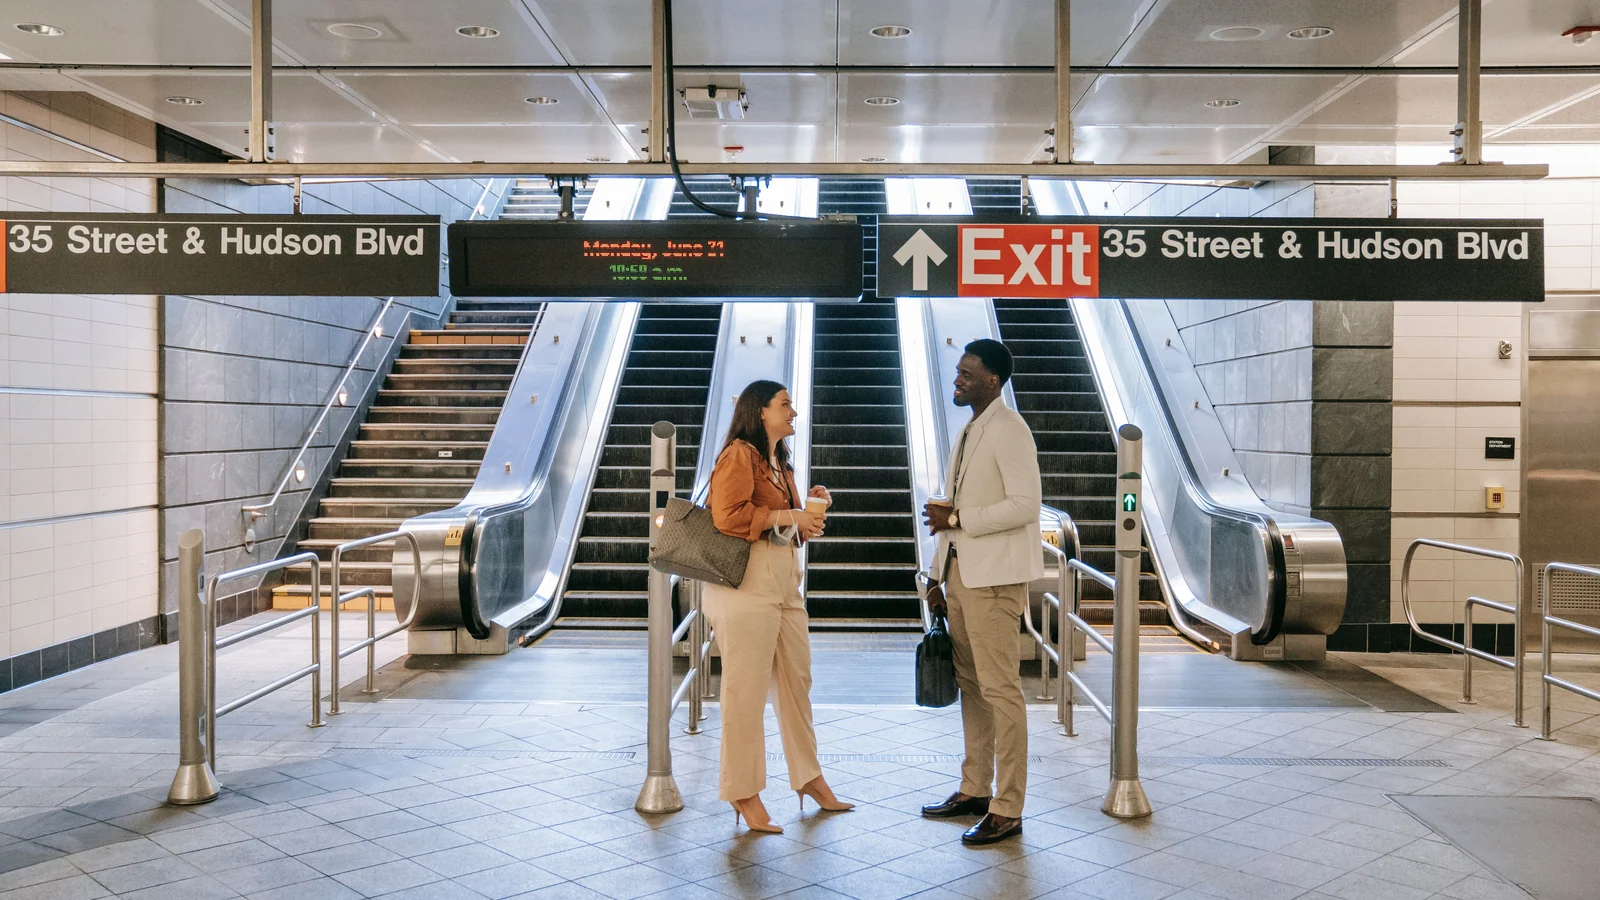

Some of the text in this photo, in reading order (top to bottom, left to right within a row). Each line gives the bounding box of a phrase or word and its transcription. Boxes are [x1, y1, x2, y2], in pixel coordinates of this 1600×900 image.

[9, 225, 424, 256] 35 Street & Hudson Blvd
[583, 240, 724, 260] Monday, June 21
[1102, 229, 1529, 260] 35 Street & Hudson Blvd
[961, 228, 1092, 286] Exit
